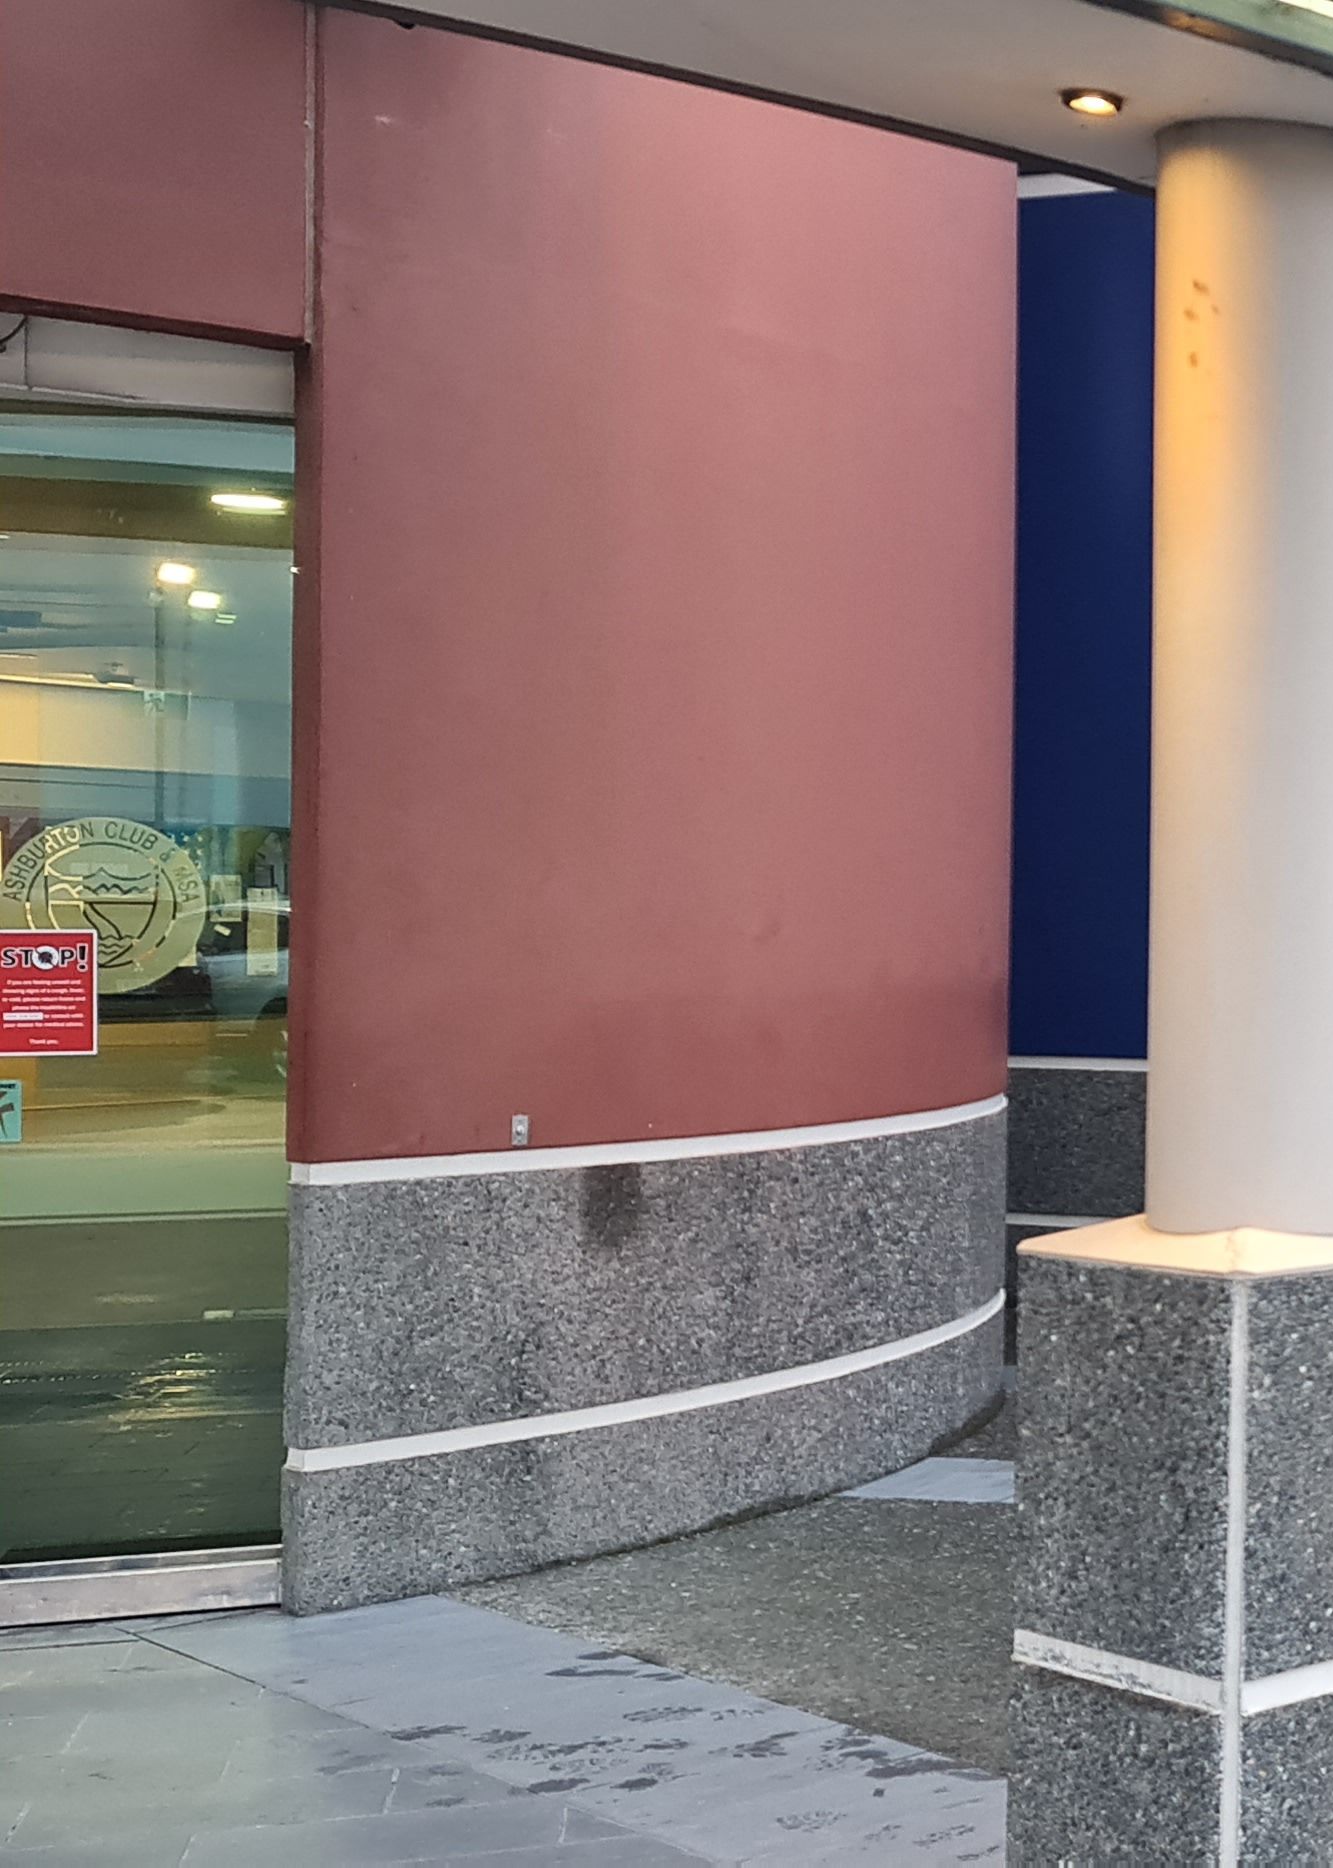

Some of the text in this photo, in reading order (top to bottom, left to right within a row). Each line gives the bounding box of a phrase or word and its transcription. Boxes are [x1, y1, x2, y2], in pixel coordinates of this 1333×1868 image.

[3, 821, 95, 902] ASHBURTON
[104, 820, 158, 850] CLUB
[171, 864, 199, 903] MSA
[1, 943, 89, 972] STOP!
